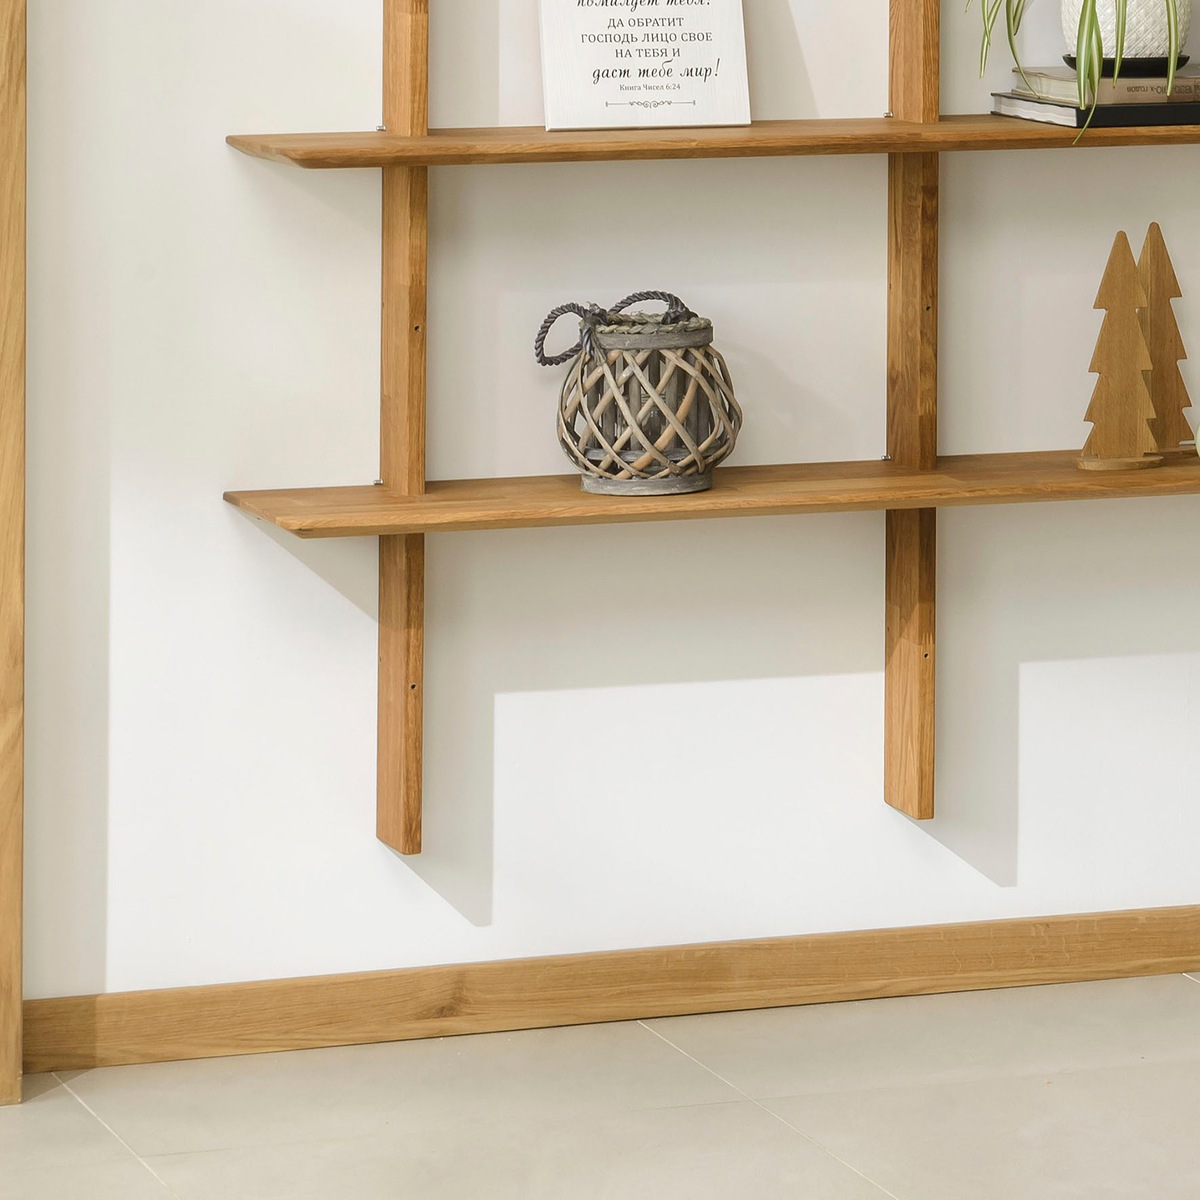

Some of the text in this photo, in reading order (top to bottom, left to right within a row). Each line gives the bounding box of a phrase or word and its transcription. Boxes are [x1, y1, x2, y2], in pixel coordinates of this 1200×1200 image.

[607, 17, 685, 29] ДА ОБРАТИТ
[581, 32, 713, 44] ГОСПОДЬ ЛИЦО СВОЕ
[615, 48, 681, 58] НА ТЕБЯ И
[592, 58, 721, 85] даст тебе мир!
[619, 83, 681, 92] Книга Чисел 6:24
